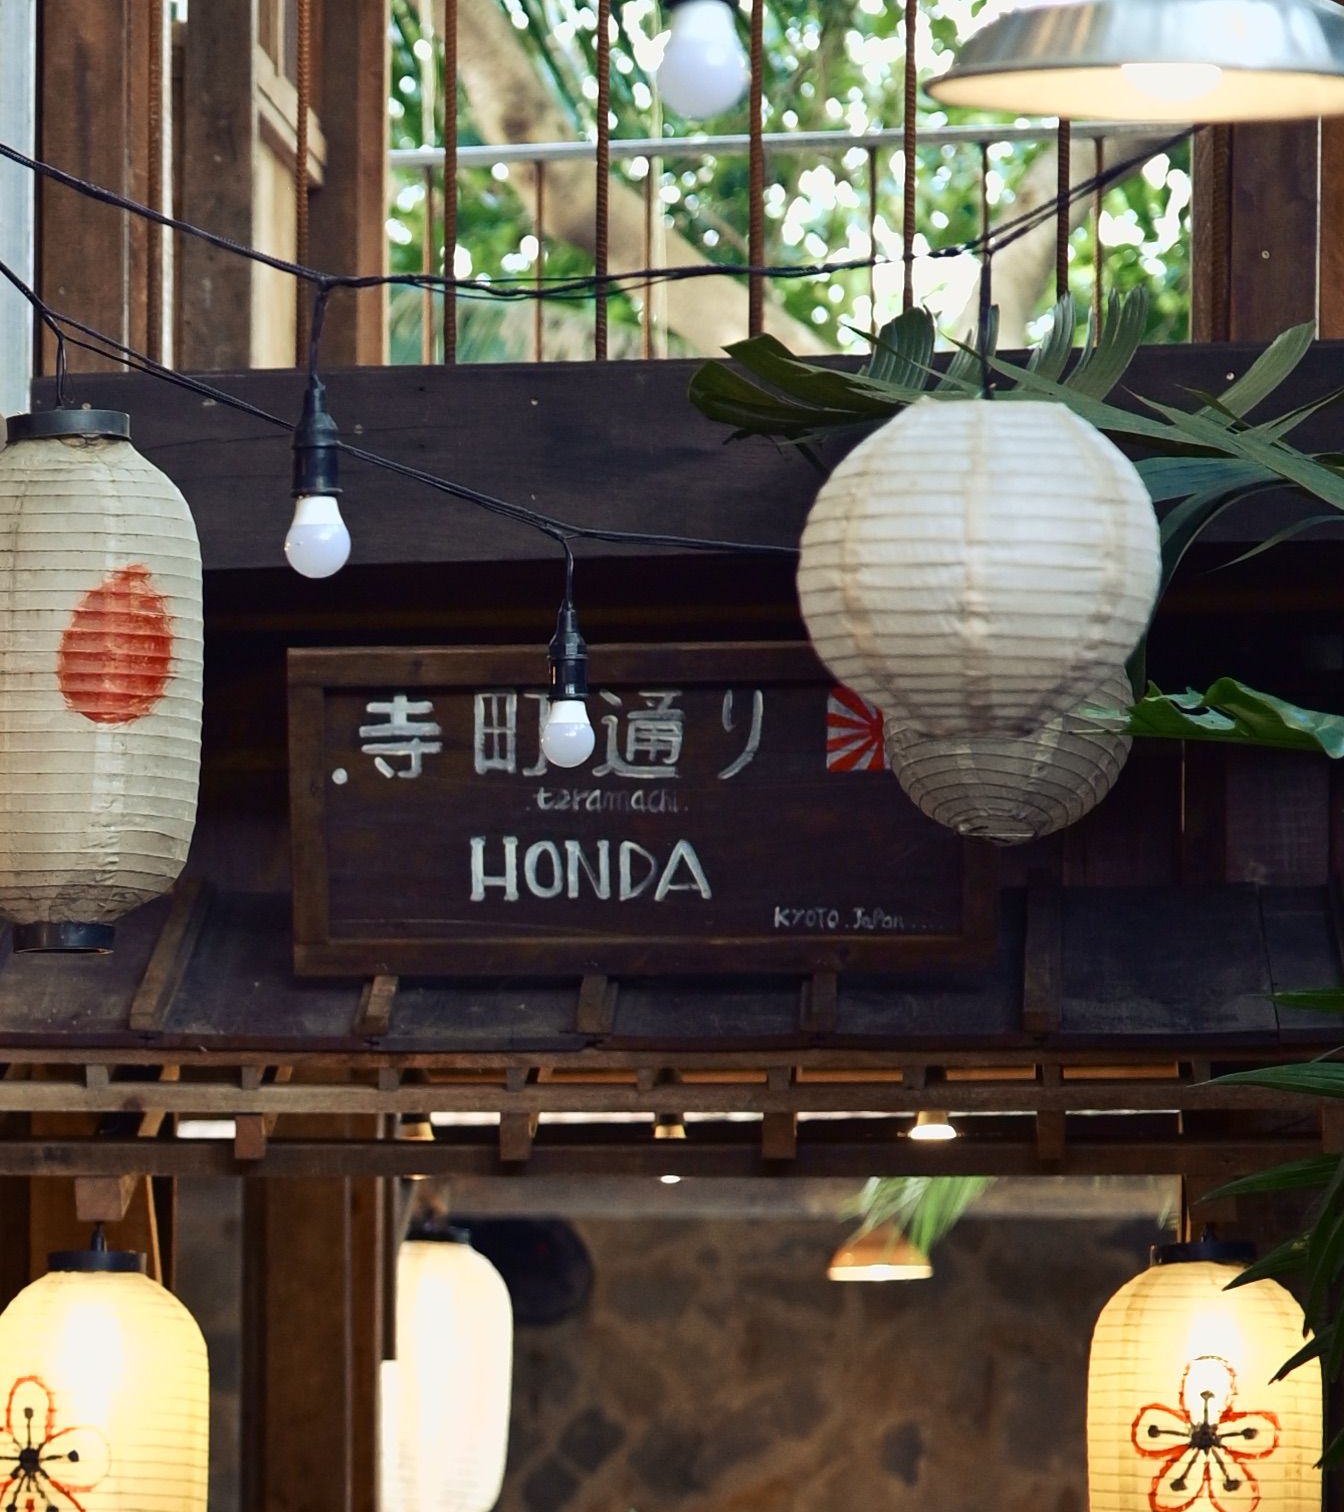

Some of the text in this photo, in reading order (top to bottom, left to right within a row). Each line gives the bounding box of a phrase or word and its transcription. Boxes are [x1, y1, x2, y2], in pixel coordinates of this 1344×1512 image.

[359, 688, 764, 780] 寺町通り
[469, 835, 711, 901] HONDA
